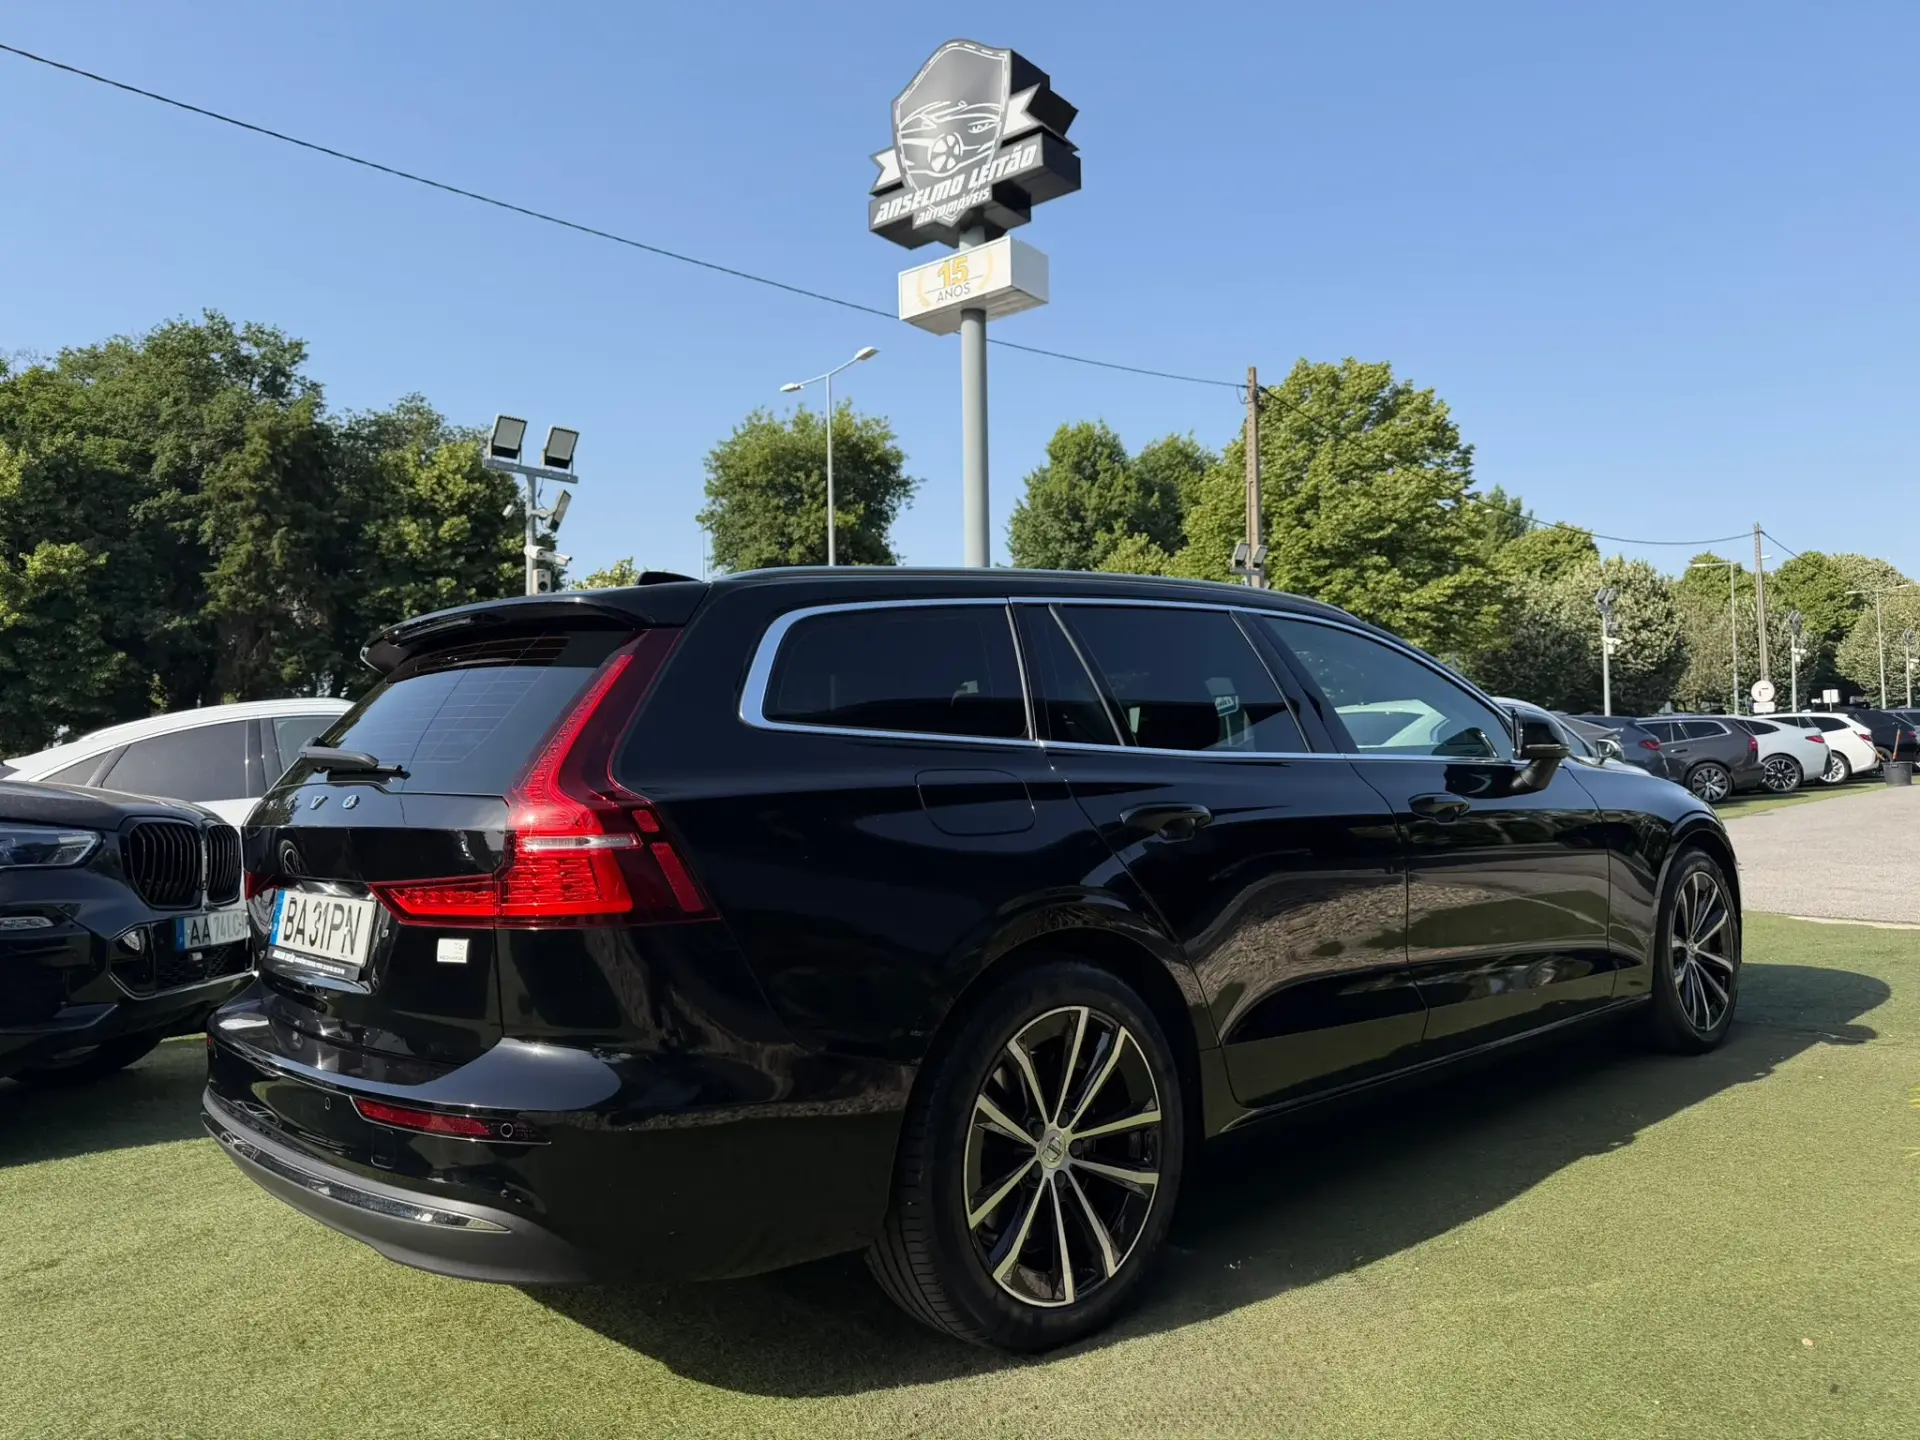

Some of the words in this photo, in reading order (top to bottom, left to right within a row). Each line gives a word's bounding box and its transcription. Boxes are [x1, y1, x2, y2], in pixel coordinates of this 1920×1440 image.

[873, 173, 966, 225] ANSELMO
[968, 144, 1038, 189] LEITÃO
[915, 187, 991, 225] AUTOMÓVEIS
[937, 255, 969, 289] 15
[936, 282, 971, 304] ANOS
